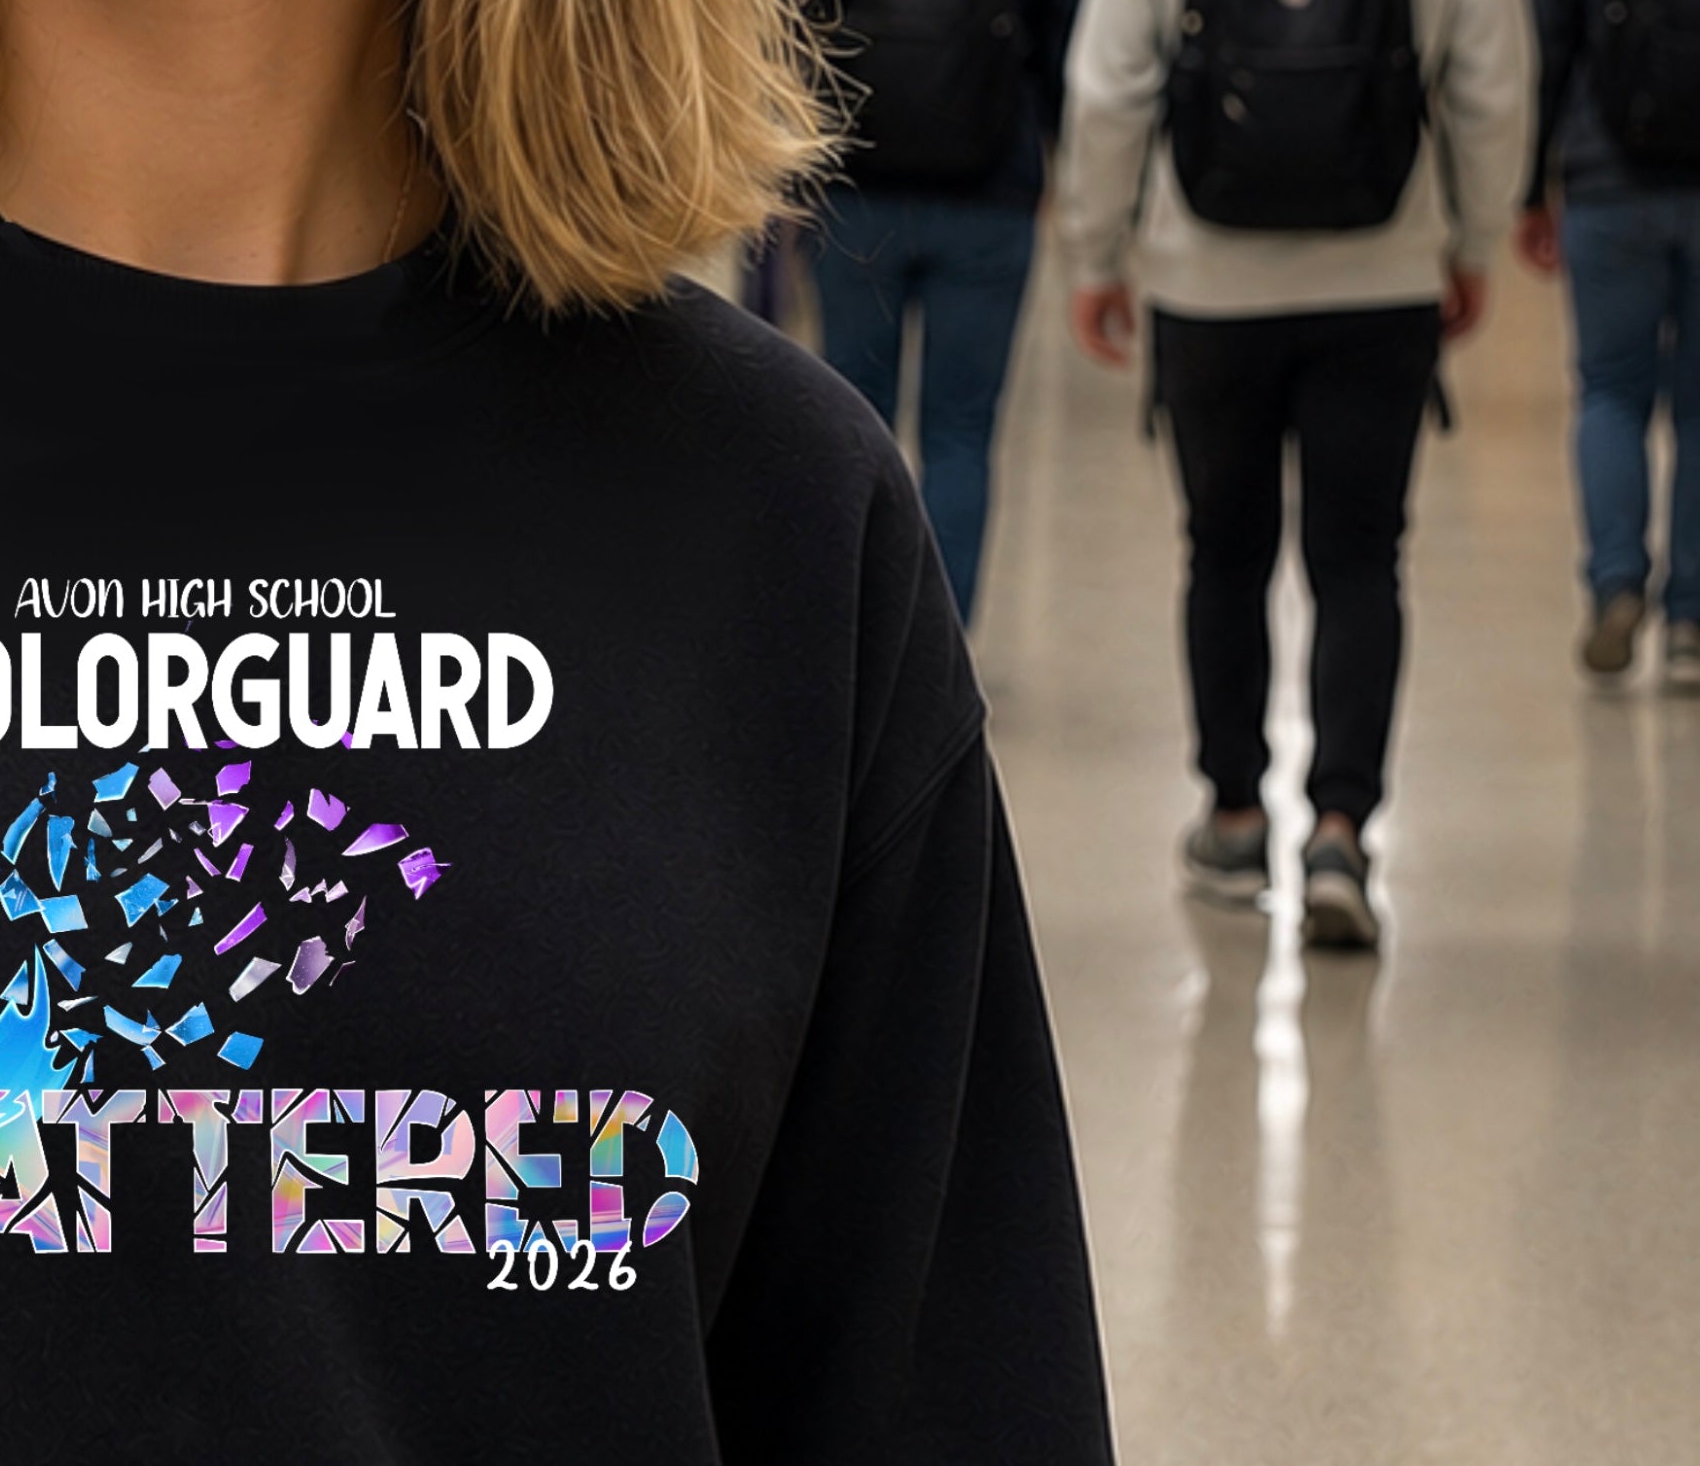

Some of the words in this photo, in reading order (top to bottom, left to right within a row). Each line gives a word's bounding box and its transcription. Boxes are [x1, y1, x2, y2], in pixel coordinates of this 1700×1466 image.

[141, 577, 233, 619] HIGH
[247, 577, 398, 620] SCHOOL
[485, 1237, 640, 1292] 2026
